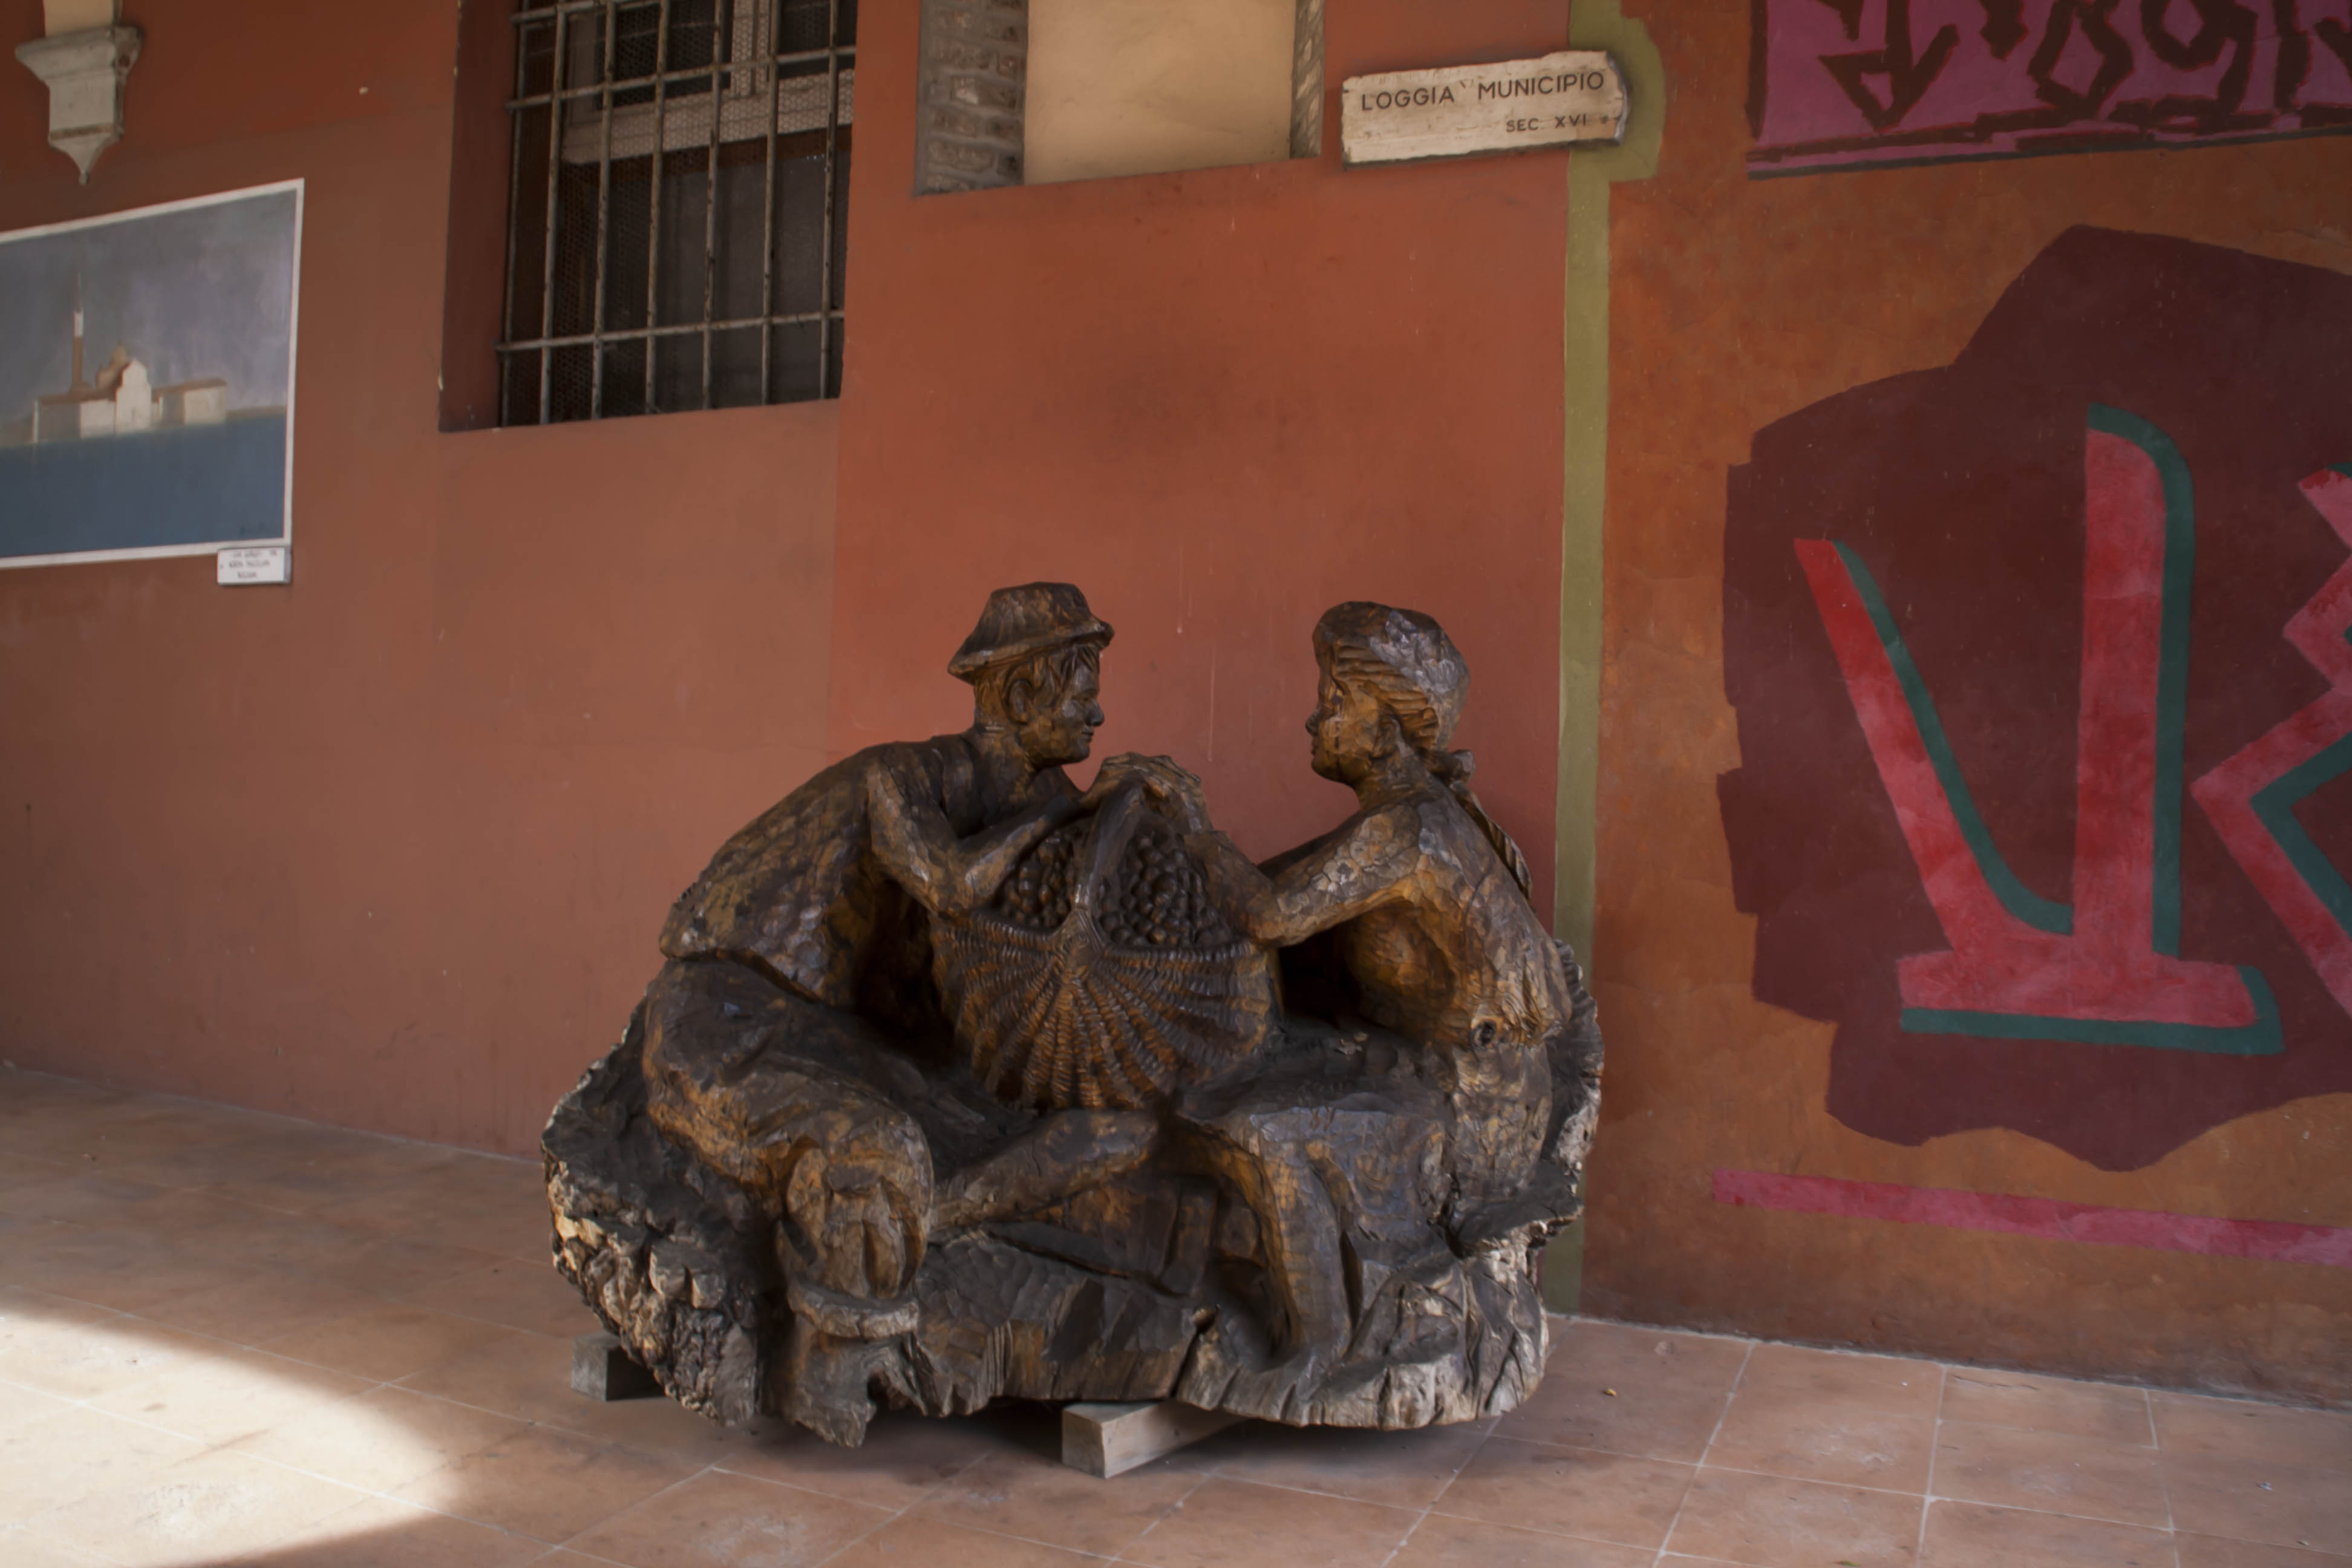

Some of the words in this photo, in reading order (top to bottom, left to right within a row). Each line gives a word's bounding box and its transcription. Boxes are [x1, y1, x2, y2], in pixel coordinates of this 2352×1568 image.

[1362, 85, 1455, 111] LOGGIA
[1478, 71, 1604, 100] MUNICIPIO
[1506, 117, 1539, 132] SEC
[1555, 113, 1587, 129] XVI
